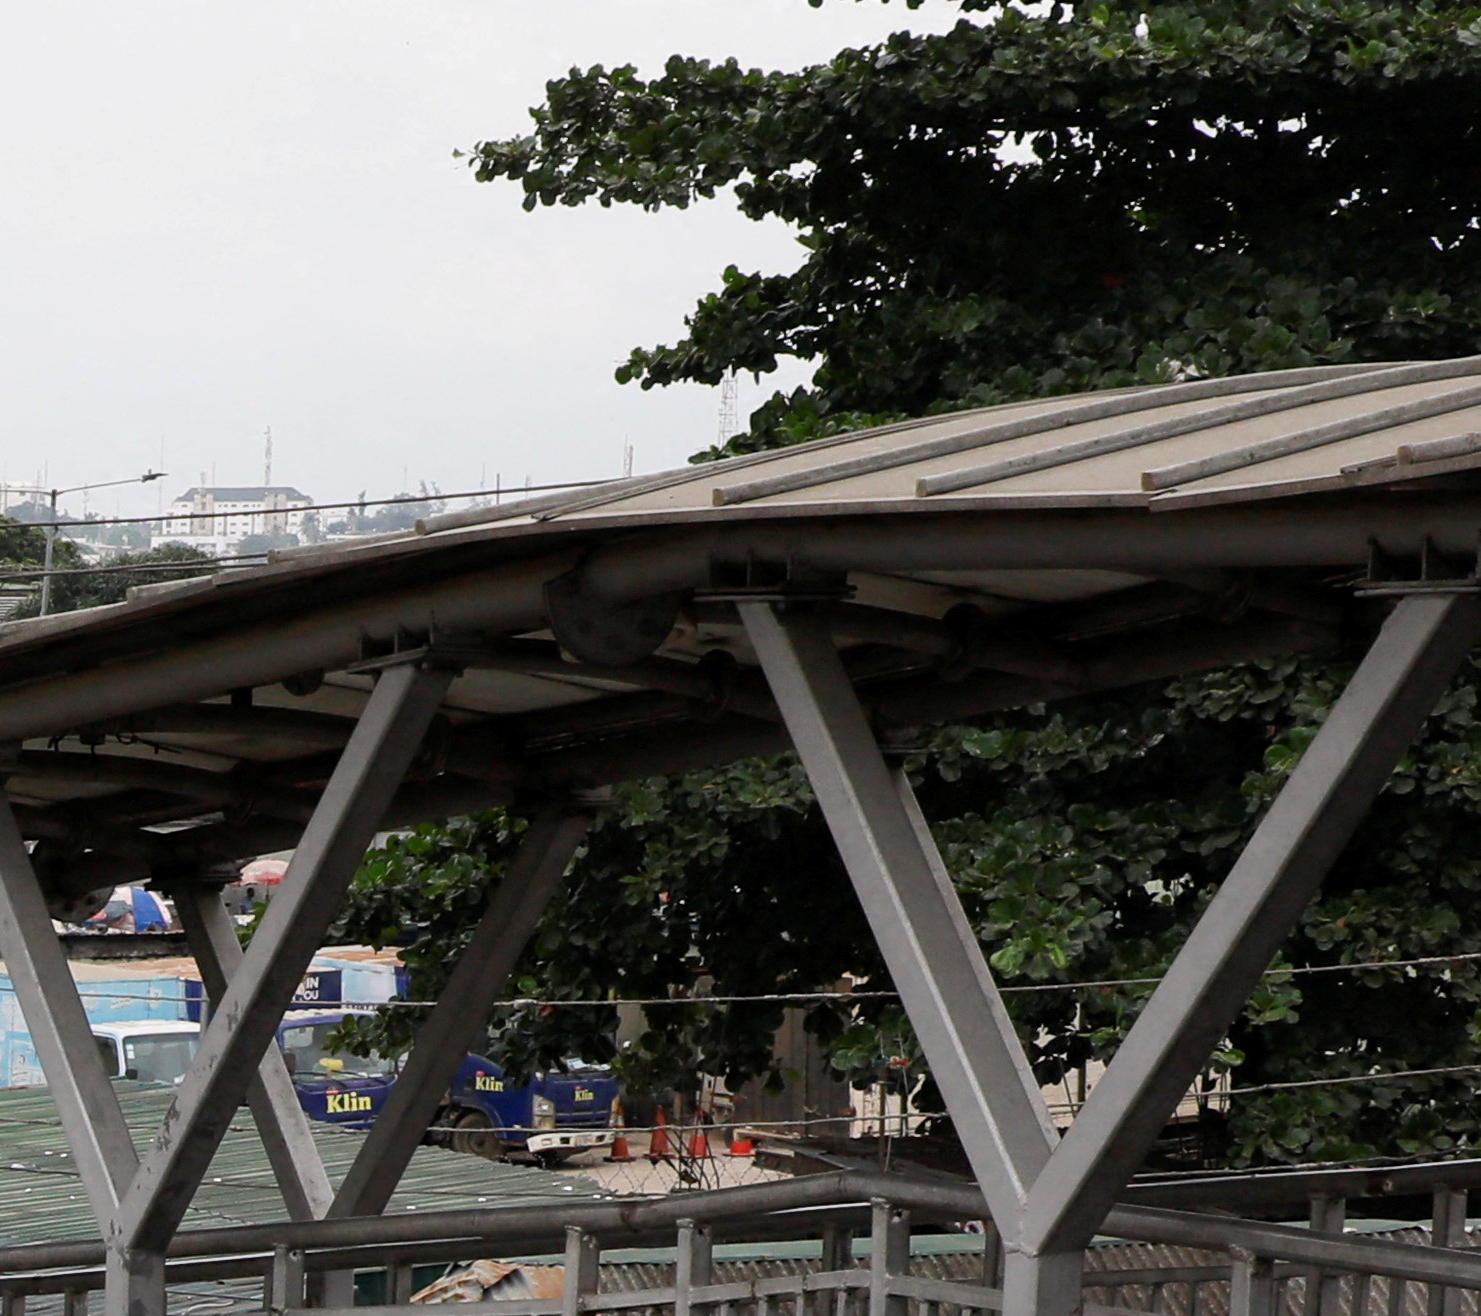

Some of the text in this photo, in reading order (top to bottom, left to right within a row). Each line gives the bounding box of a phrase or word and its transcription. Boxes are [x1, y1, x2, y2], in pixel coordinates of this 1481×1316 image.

[475, 1076, 504, 1092] Klin
[326, 1091, 373, 1114] Klin
[574, 1089, 595, 1102] Klin
